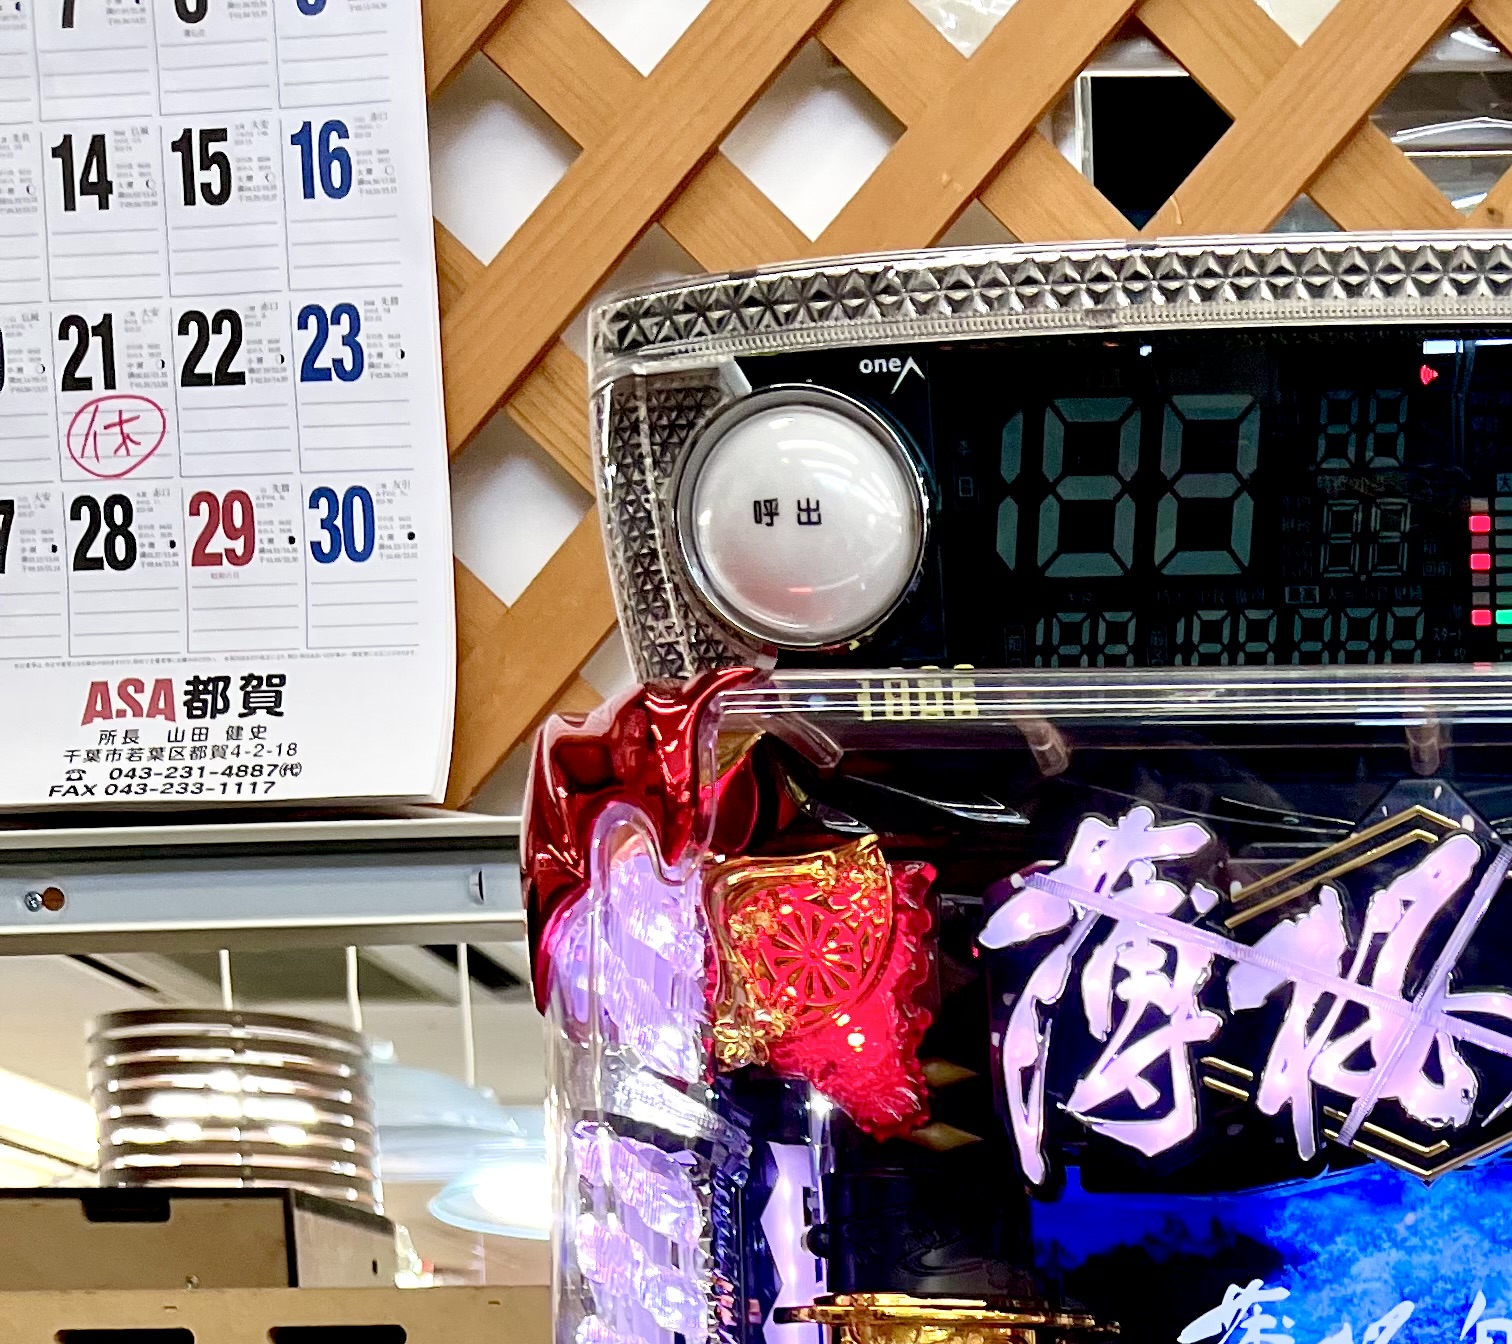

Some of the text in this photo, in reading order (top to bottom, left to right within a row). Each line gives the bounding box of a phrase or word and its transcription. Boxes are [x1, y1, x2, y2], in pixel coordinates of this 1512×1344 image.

[51, 134, 113, 212] 14
[171, 128, 231, 206] 15
[291, 119, 352, 200] 16
[58, 313, 118, 392] 21
[177, 309, 246, 387] 22
[298, 303, 365, 382] 23
[80, 404, 142, 463] 休
[70, 494, 137, 571] 28
[188, 490, 255, 568] 29
[308, 485, 375, 564] 30
[752, 496, 824, 528] 呼出
[98, 728, 140, 746] 所長
[167, 726, 209, 744] 山田
[49, 781, 276, 798] FAX 043-233-1117
